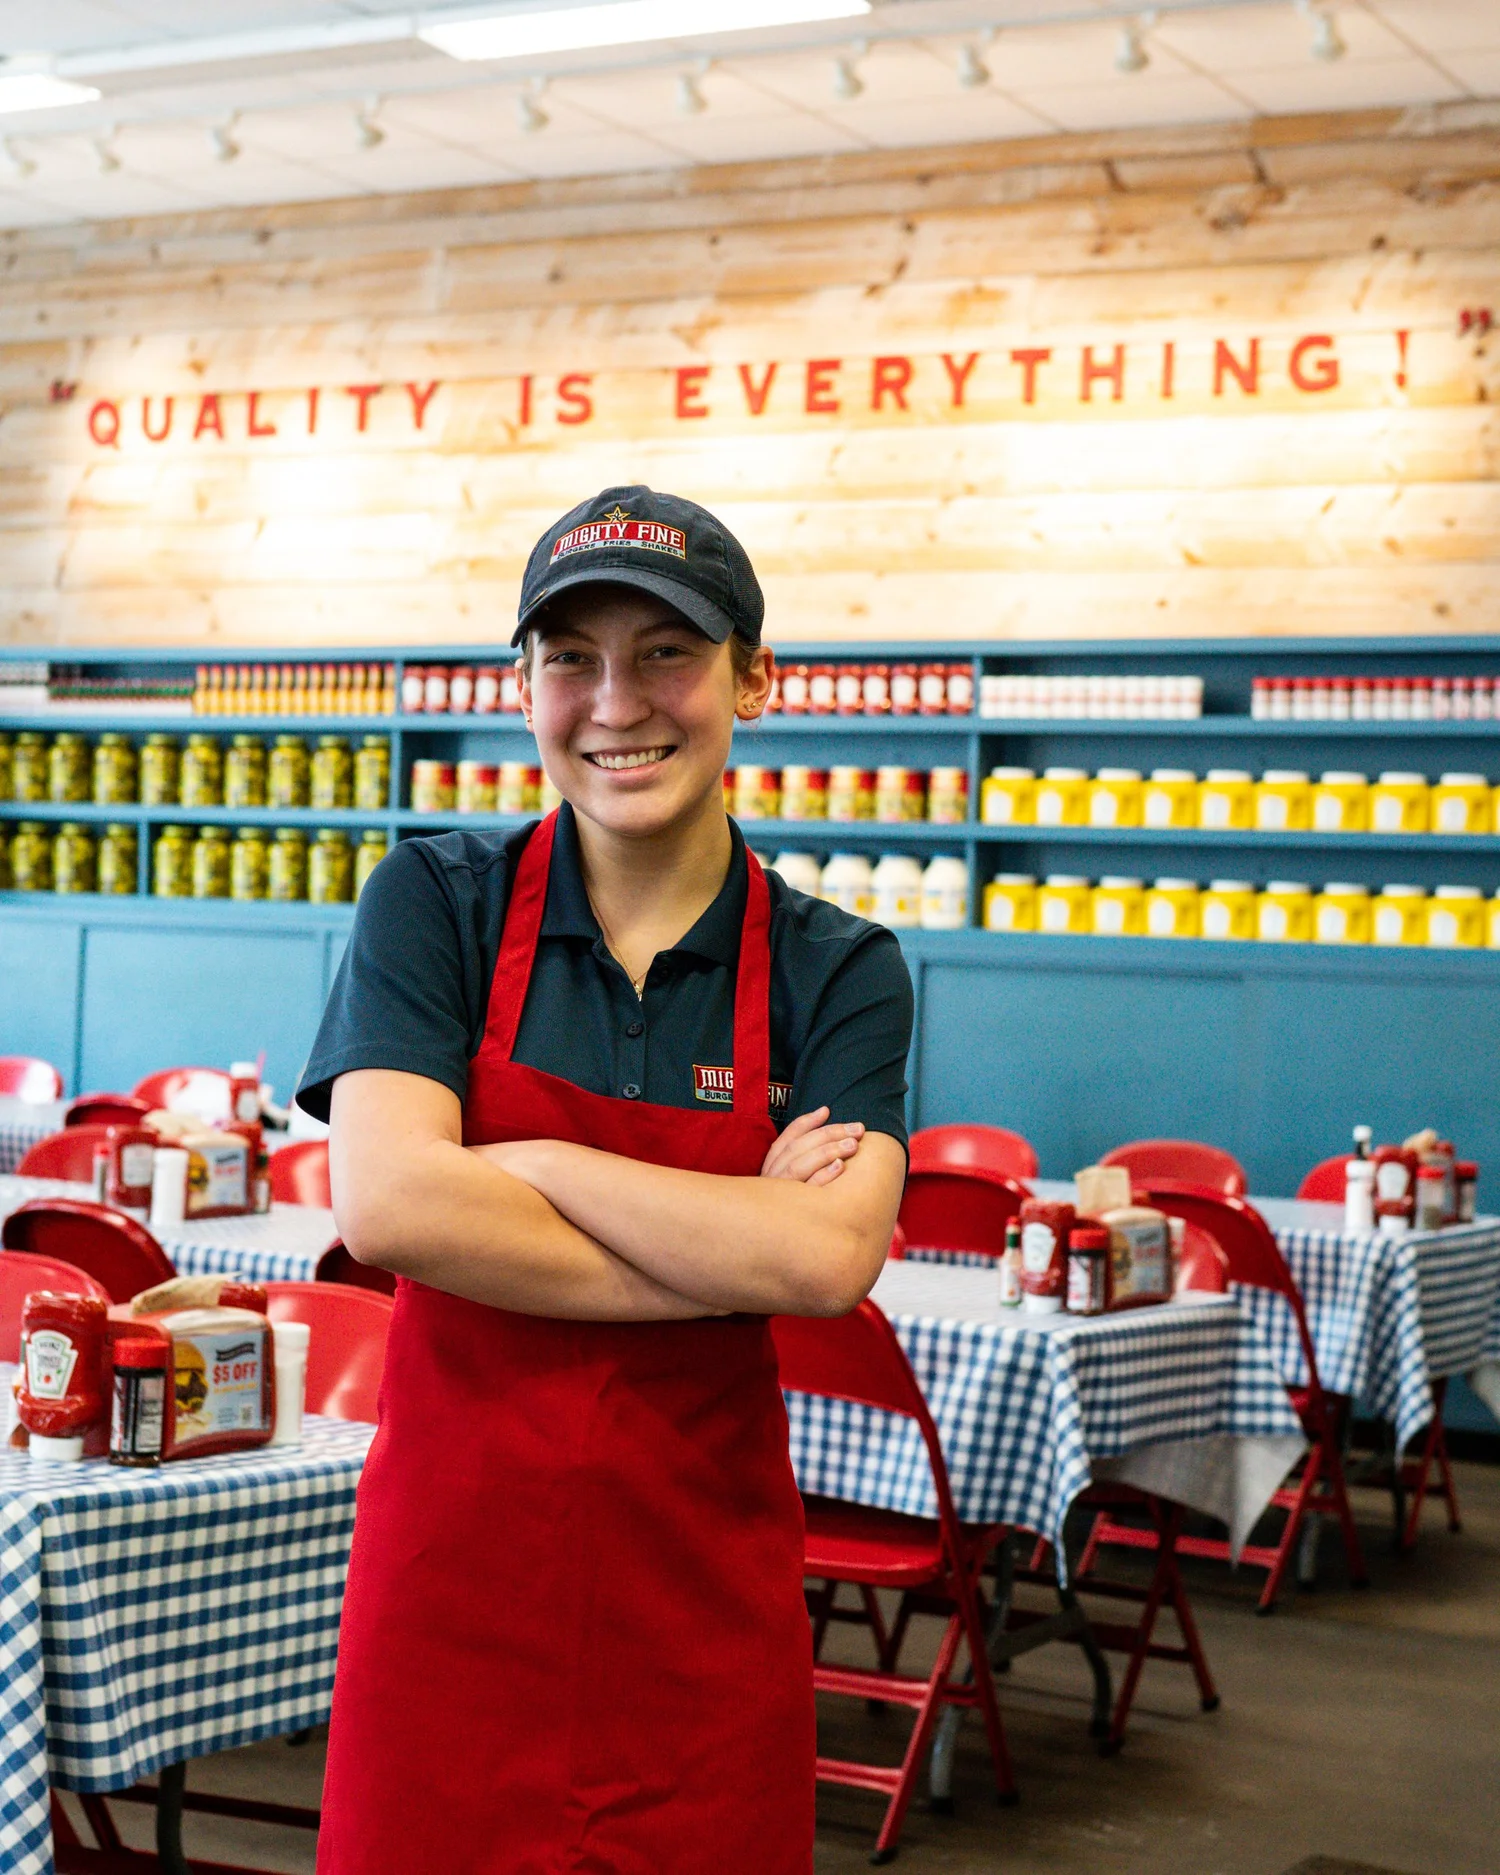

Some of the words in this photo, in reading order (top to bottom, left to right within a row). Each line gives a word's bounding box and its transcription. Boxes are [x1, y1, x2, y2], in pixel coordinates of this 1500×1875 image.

[520, 374, 594, 426] IS
[559, 523, 628, 552] MIGHTY
[637, 524, 682, 547] FINE
[640, 541, 679, 555] SHAKES
[700, 1068, 734, 1089] MIG
[768, 1085, 792, 1107] IN
[213, 1363, 230, 1385] $5
[233, 1361, 258, 1381] OFF
